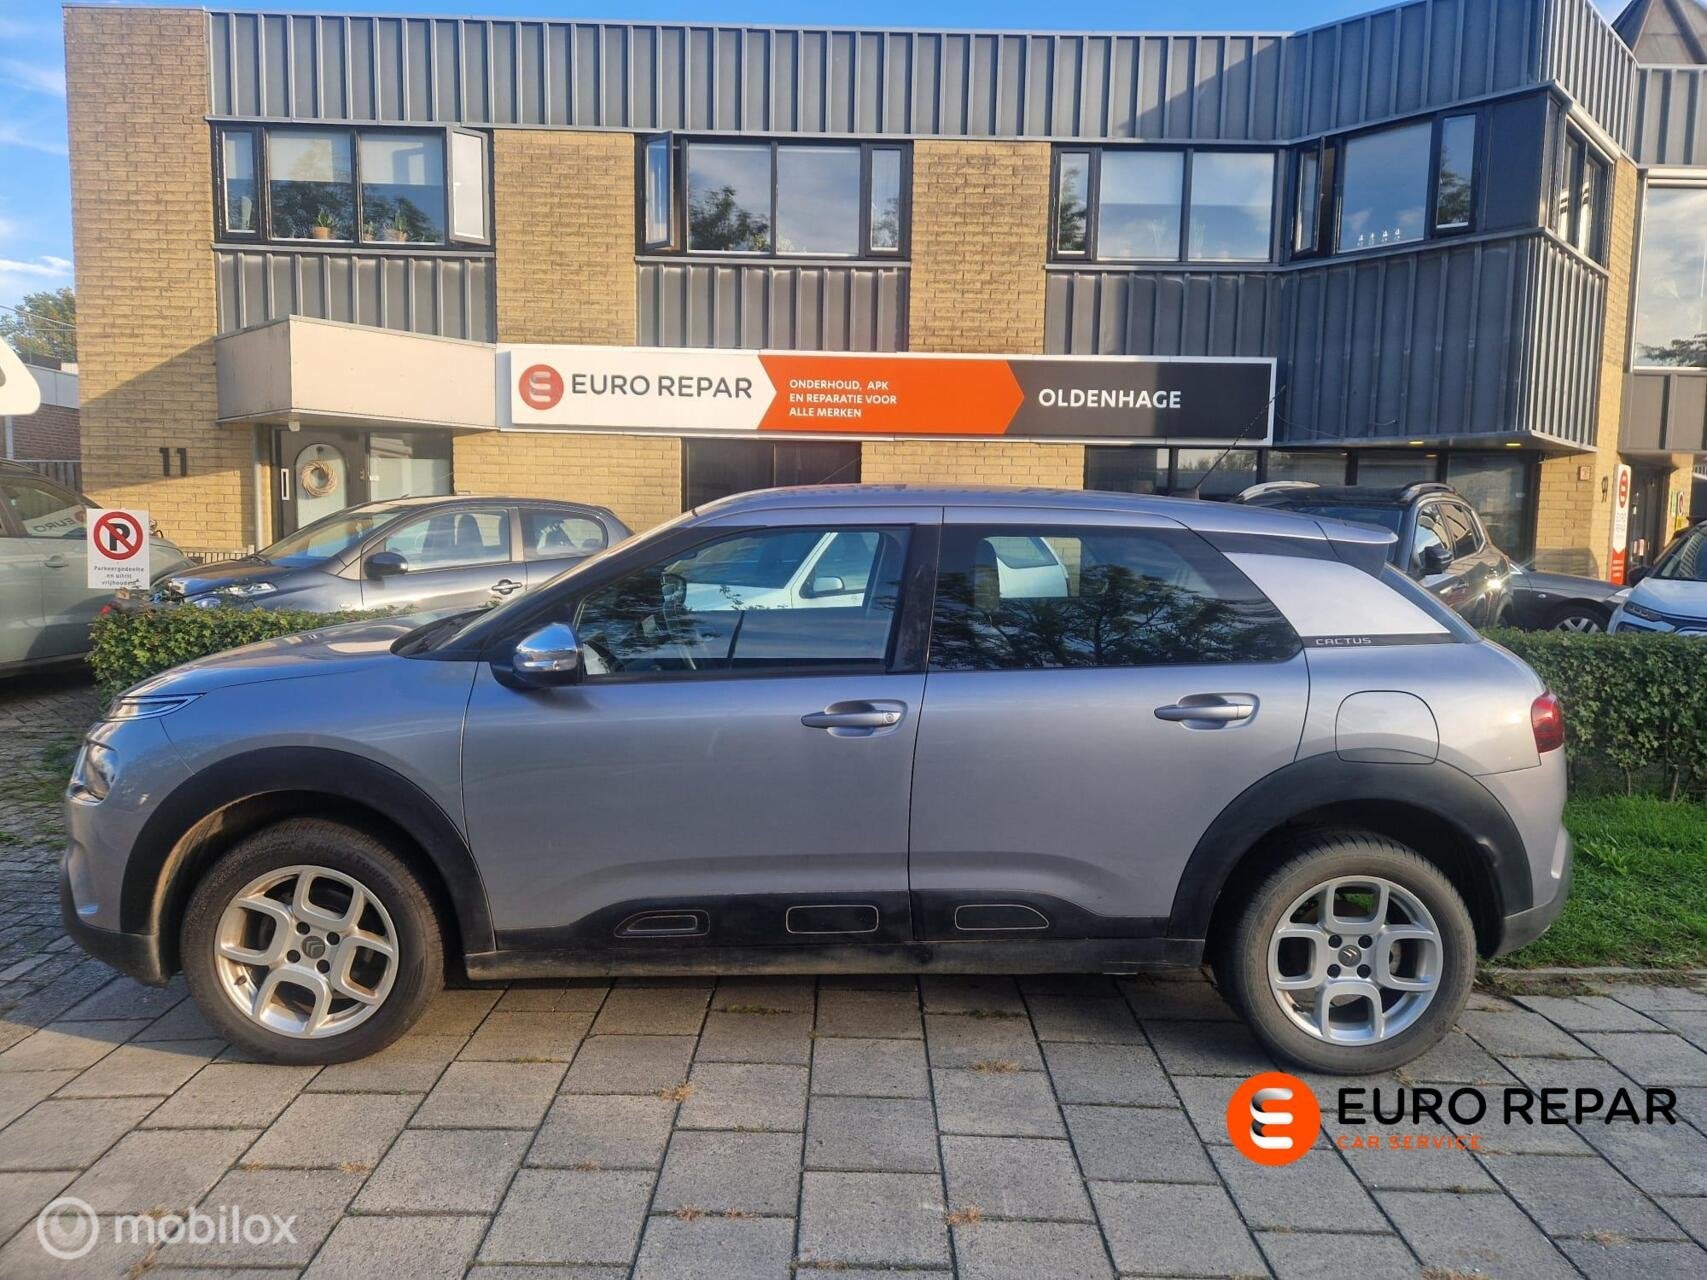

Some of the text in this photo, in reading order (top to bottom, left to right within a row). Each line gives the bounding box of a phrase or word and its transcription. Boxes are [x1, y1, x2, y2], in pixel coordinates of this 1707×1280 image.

[571, 373, 753, 399] EURO REPAR
[789, 379, 889, 391] ONDERHOUD, APK
[789, 393, 897, 404] EN REPARATIE VOOR
[1038, 388, 1182, 409] OLDENHAGE
[789, 407, 862, 417] ALLE MERKEN
[159, 447, 188, 477] 11
[1315, 637, 1372, 645] CACTUS
